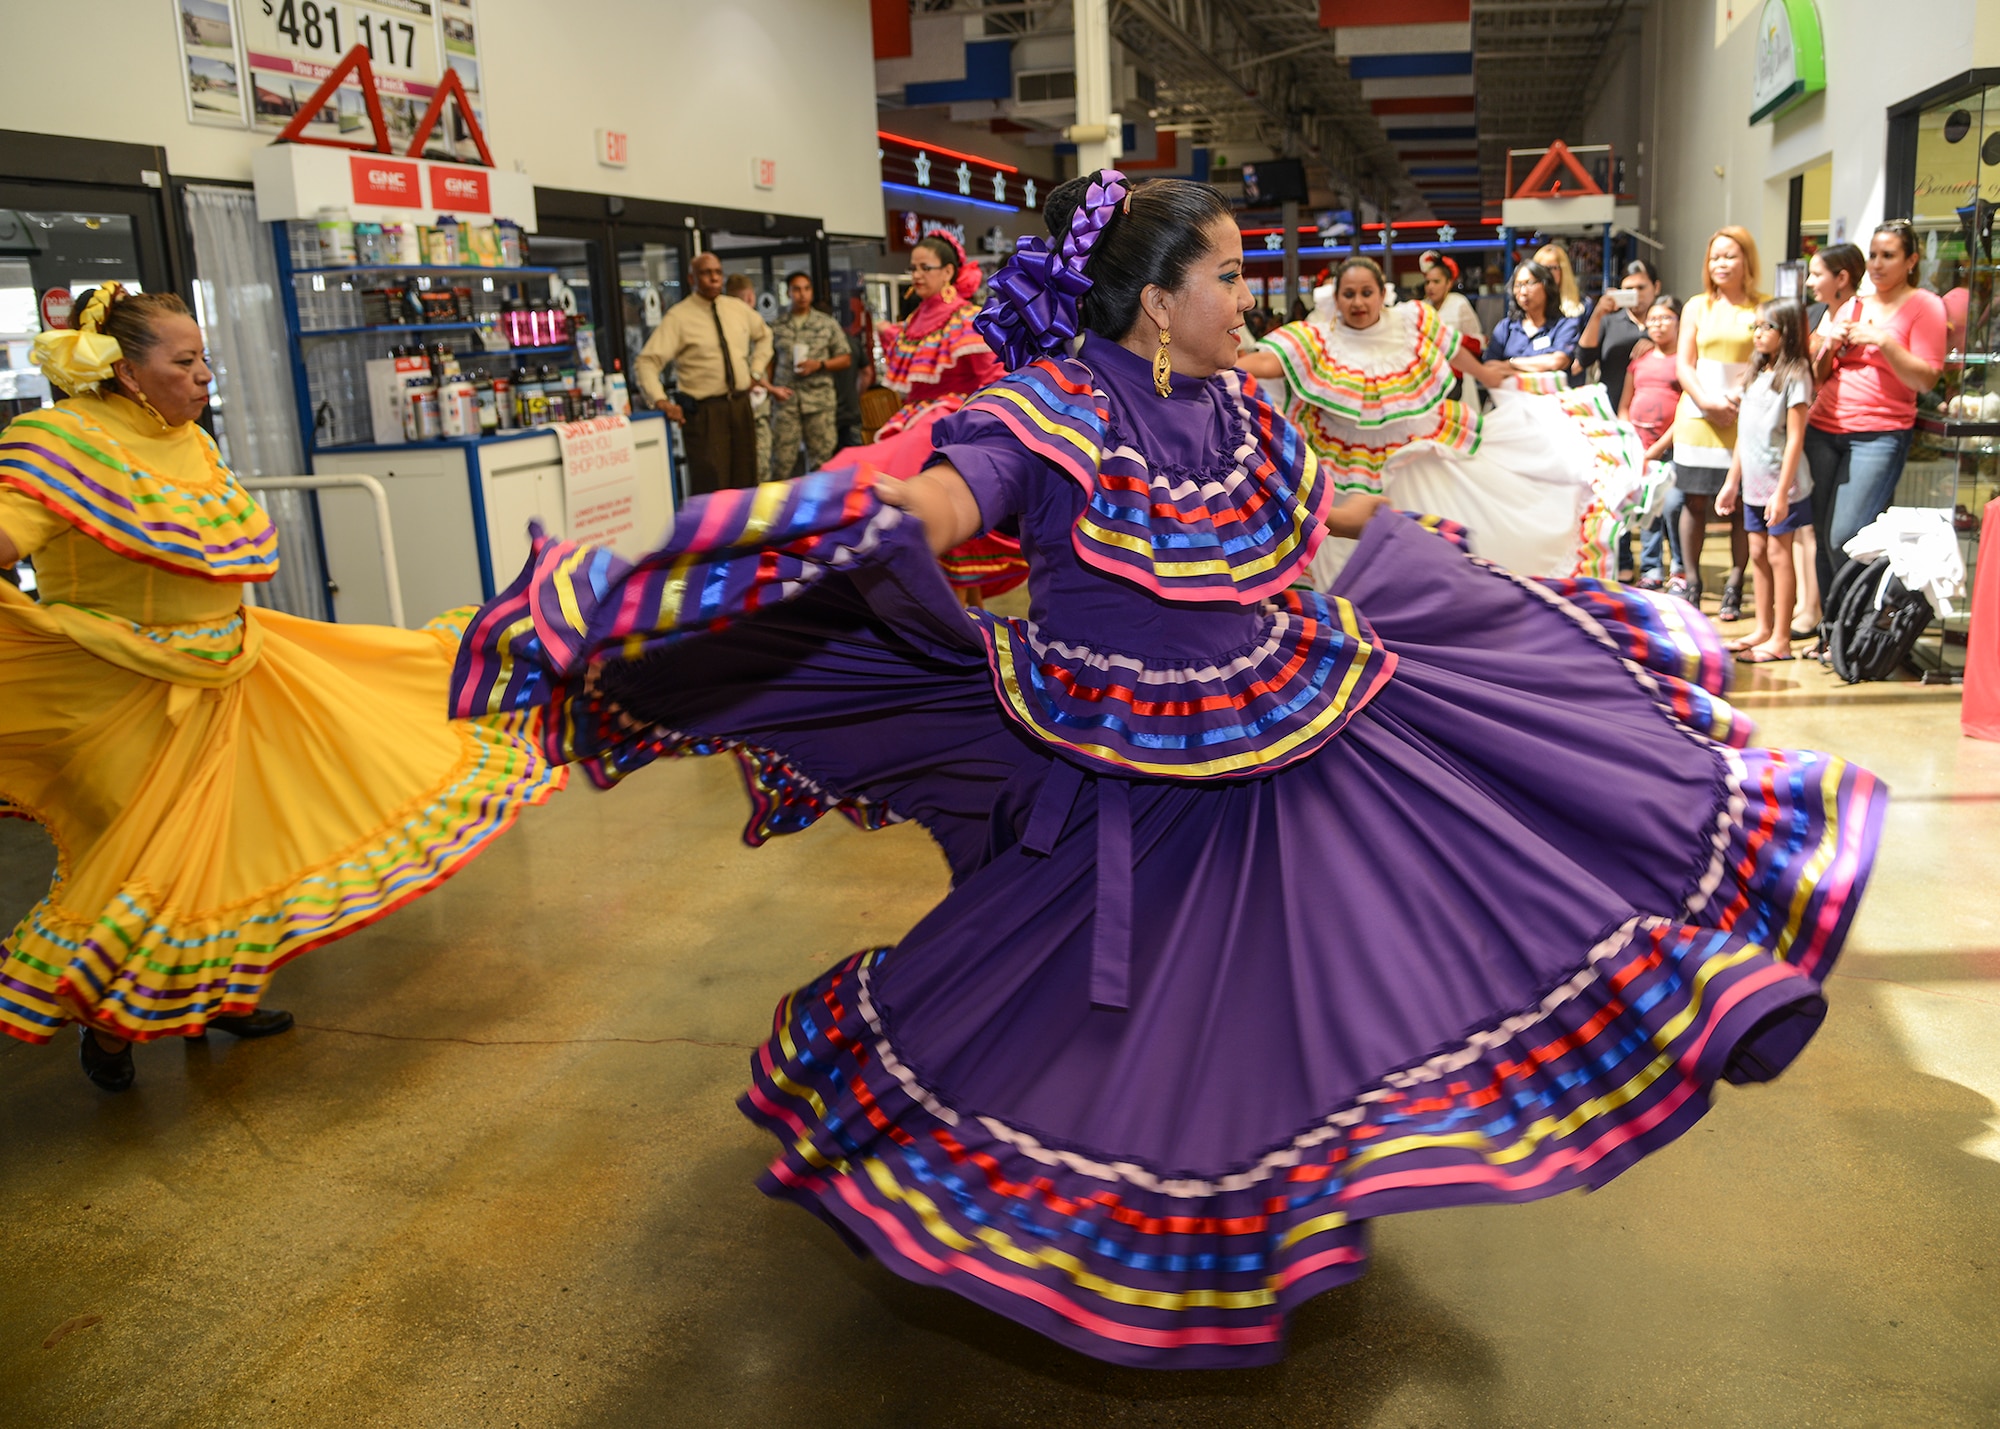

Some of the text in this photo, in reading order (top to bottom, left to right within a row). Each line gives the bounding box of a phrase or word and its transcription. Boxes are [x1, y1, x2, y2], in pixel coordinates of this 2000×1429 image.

[359, 15, 414, 67] 117
[607, 131, 627, 162] EXIT
[368, 169, 406, 187] GNC
[444, 177, 478, 194] GNC
[1914, 174, 1981, 203] Beauty
[561, 415, 626, 439] SAVE MORE
